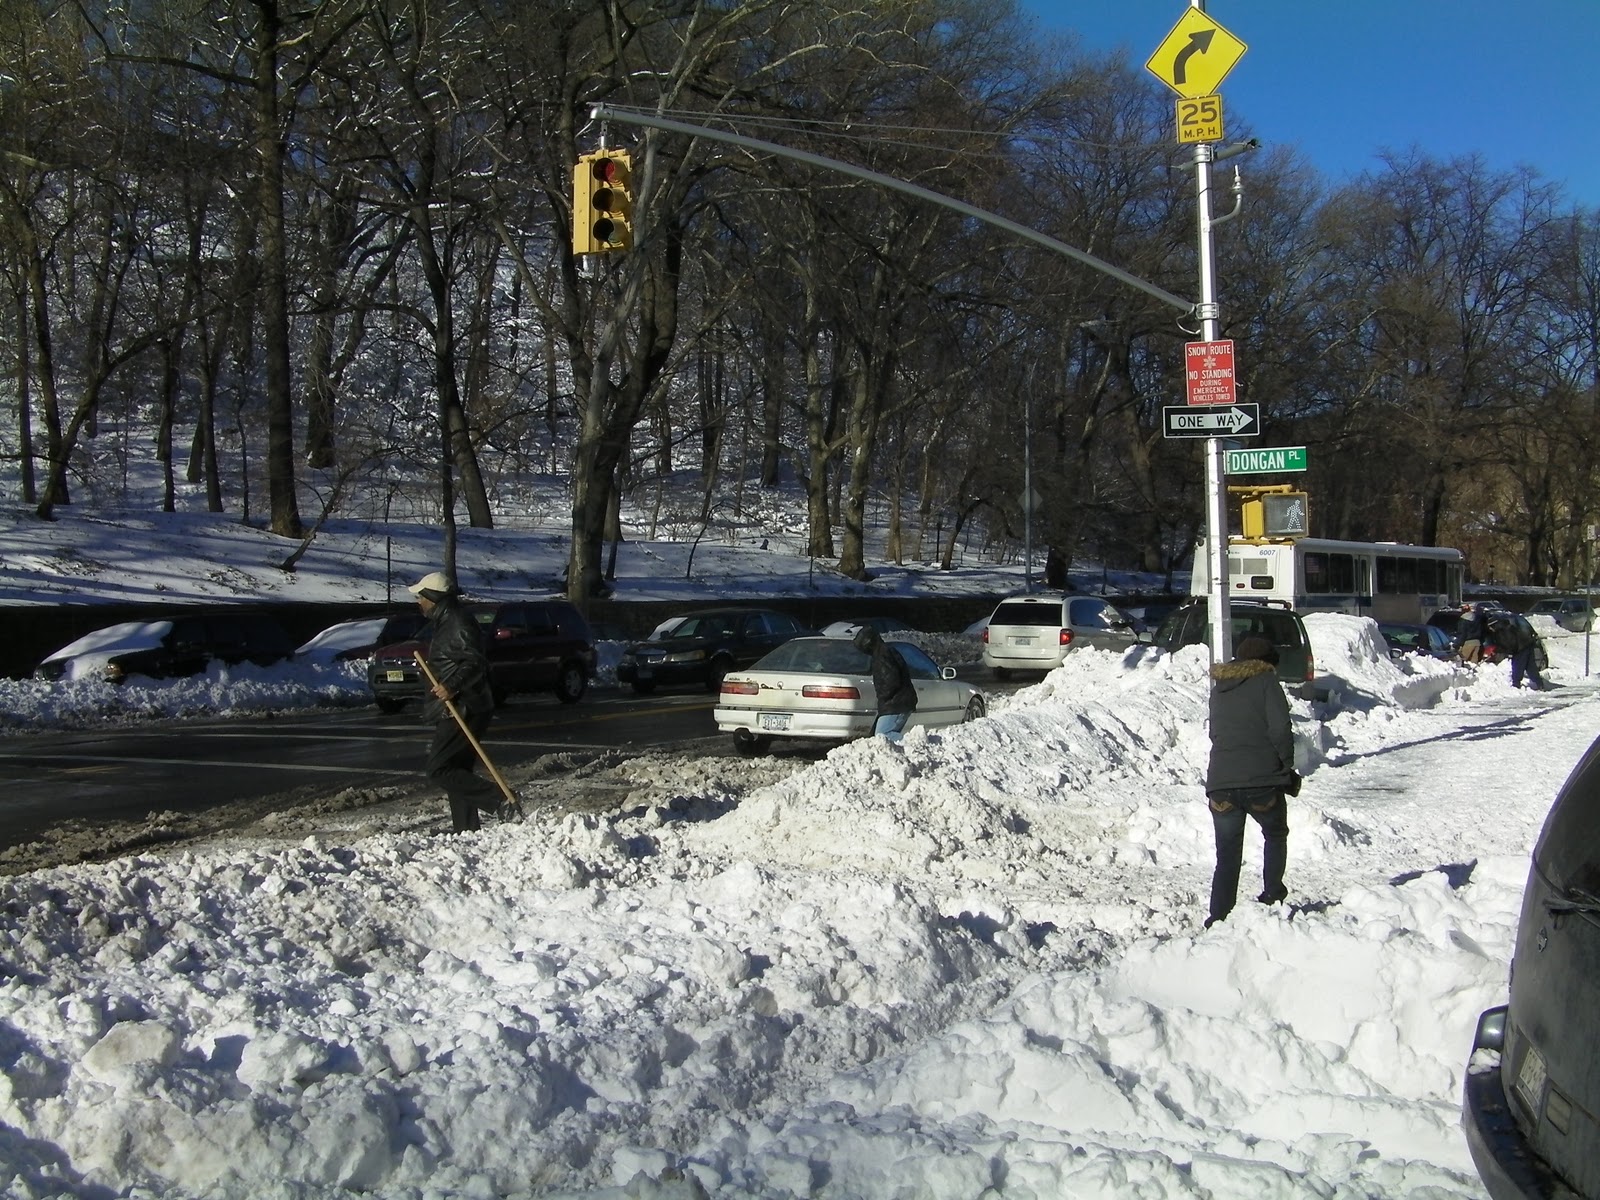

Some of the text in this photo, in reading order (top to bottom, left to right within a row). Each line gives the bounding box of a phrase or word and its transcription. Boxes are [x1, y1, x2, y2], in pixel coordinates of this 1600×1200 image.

[1181, 100, 1217, 126] 25
[1188, 344, 1231, 356] SNOW ROUTE
[1189, 368, 1232, 380] NO STANDING
[1200, 379, 1221, 387] DURING
[1193, 386, 1229, 394] EMERGENCY
[1178, 414, 1243, 428] ONE WAY
[1232, 450, 1301, 471] DONGAN PL
